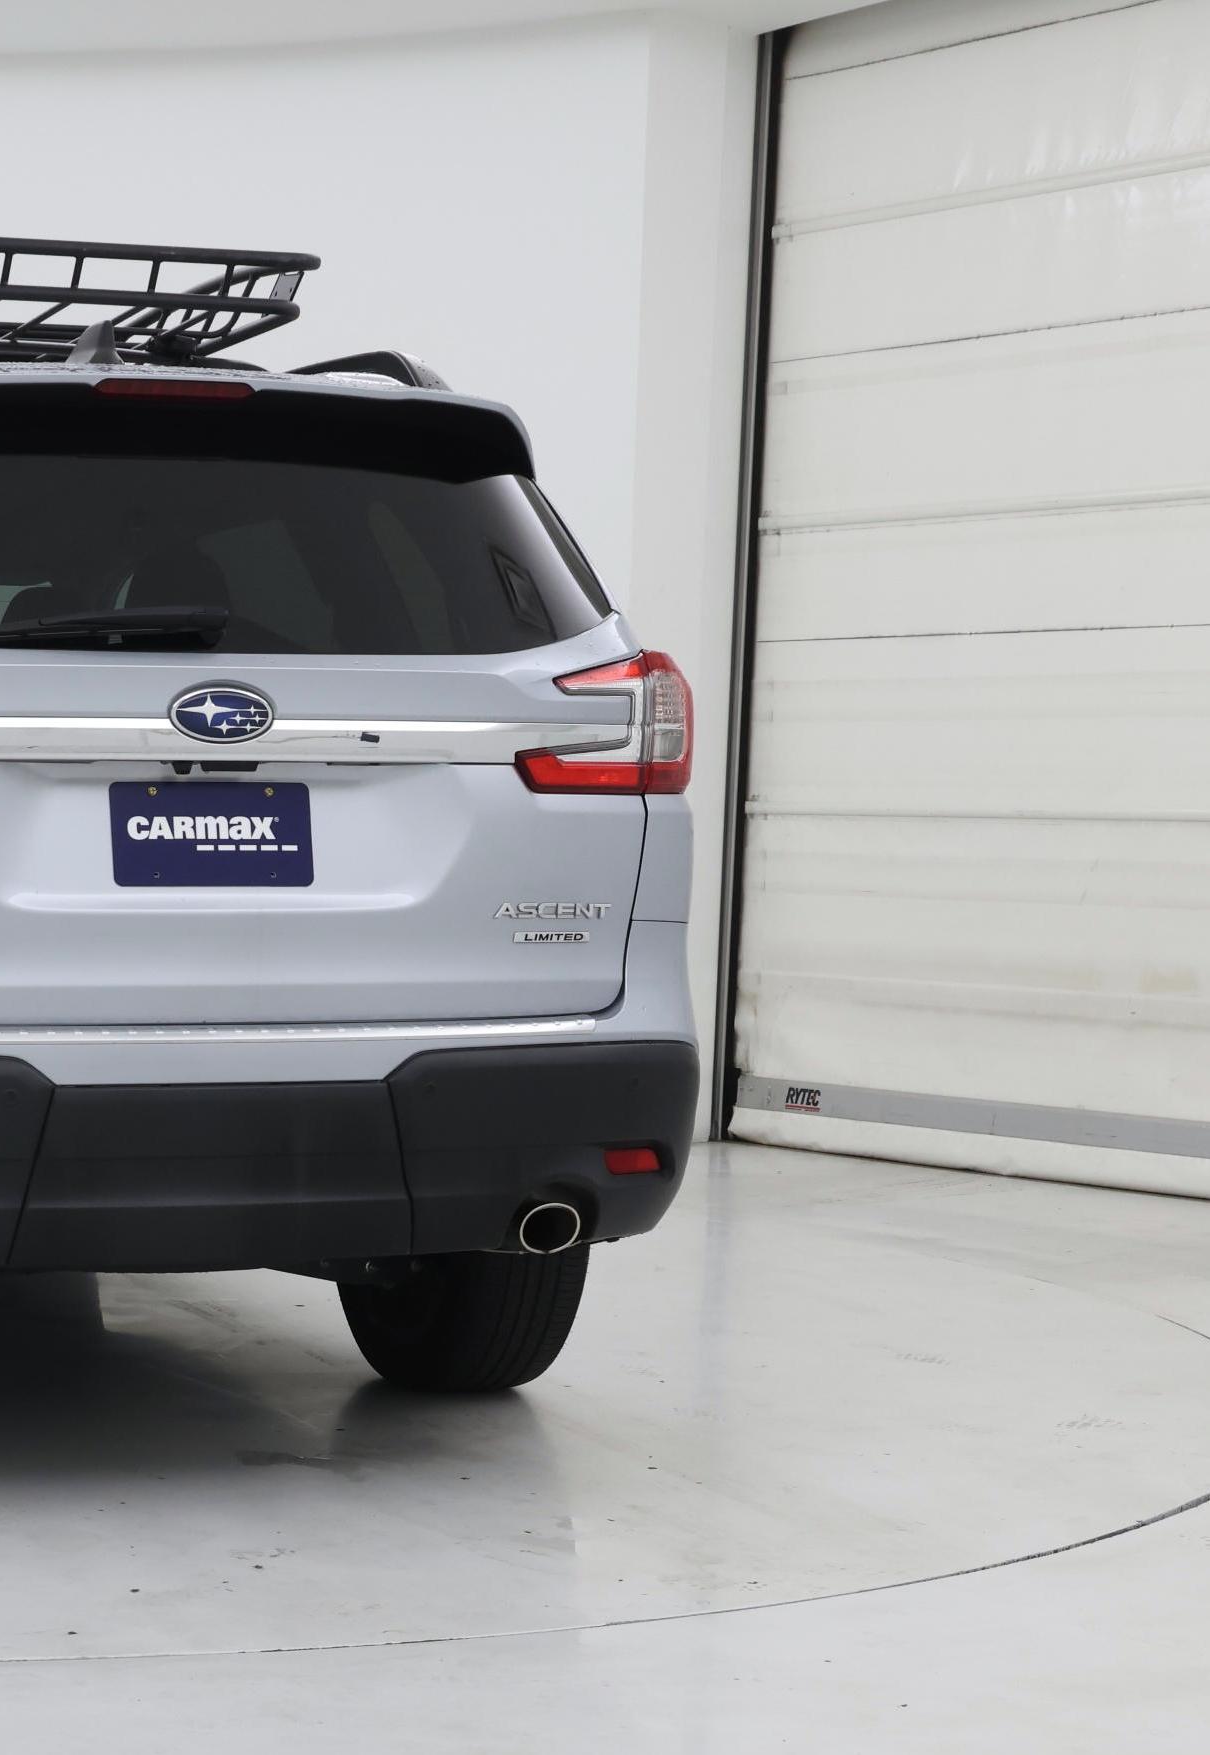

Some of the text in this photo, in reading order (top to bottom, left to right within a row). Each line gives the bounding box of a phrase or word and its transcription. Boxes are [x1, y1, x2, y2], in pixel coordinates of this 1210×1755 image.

[493, 902, 612, 919] ASCENT
[524, 933, 584, 942] LIMITED
[785, 1086, 821, 1107] RYTEC
